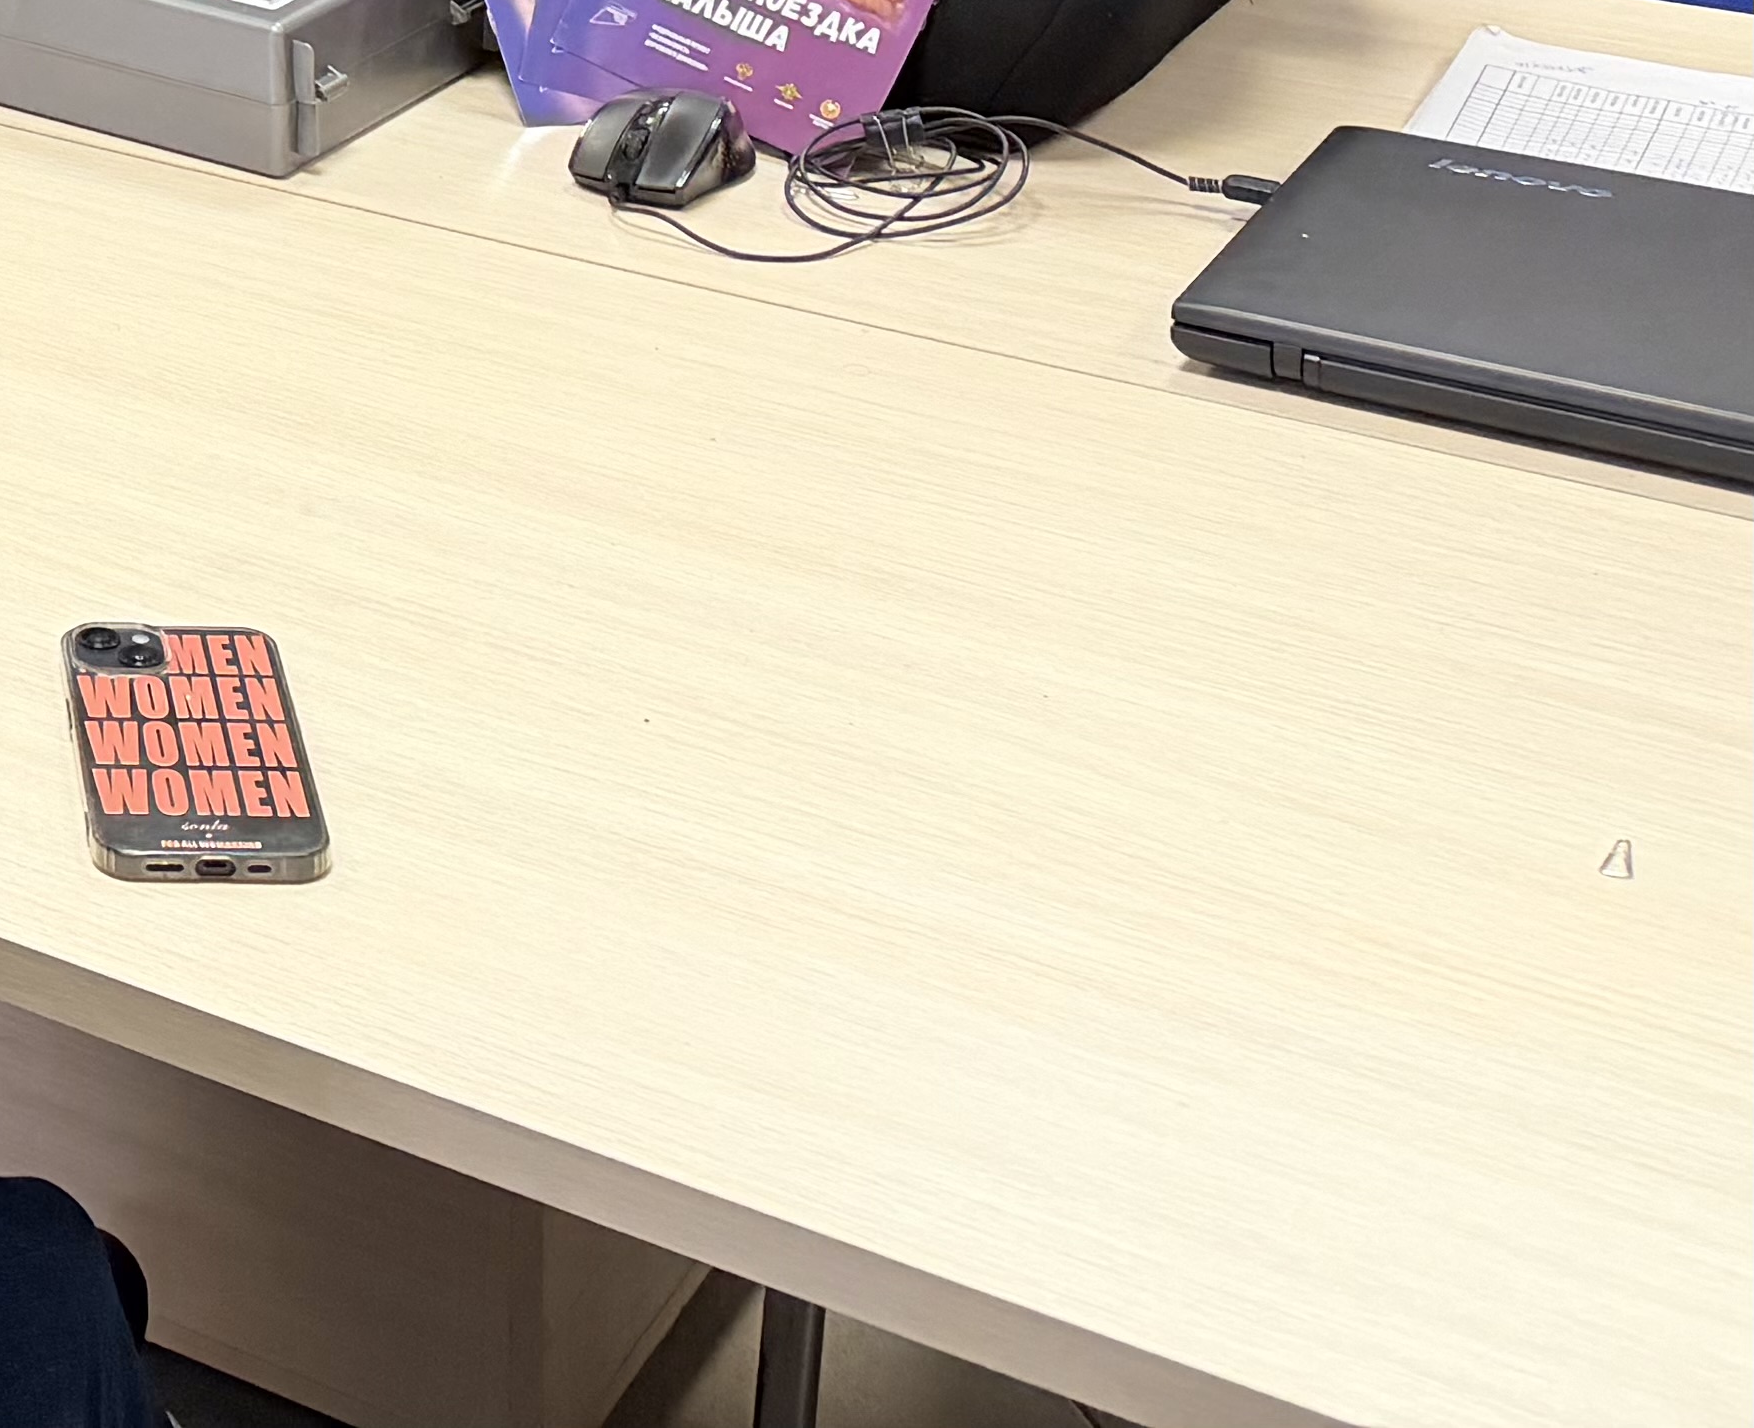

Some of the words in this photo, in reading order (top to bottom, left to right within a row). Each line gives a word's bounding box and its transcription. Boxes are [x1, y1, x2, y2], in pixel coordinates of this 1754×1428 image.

[165, 634, 273, 676] MEN
[77, 675, 285, 720] WOMEN
[84, 720, 297, 767] WOMEN
[92, 768, 311, 818] WOMEN
